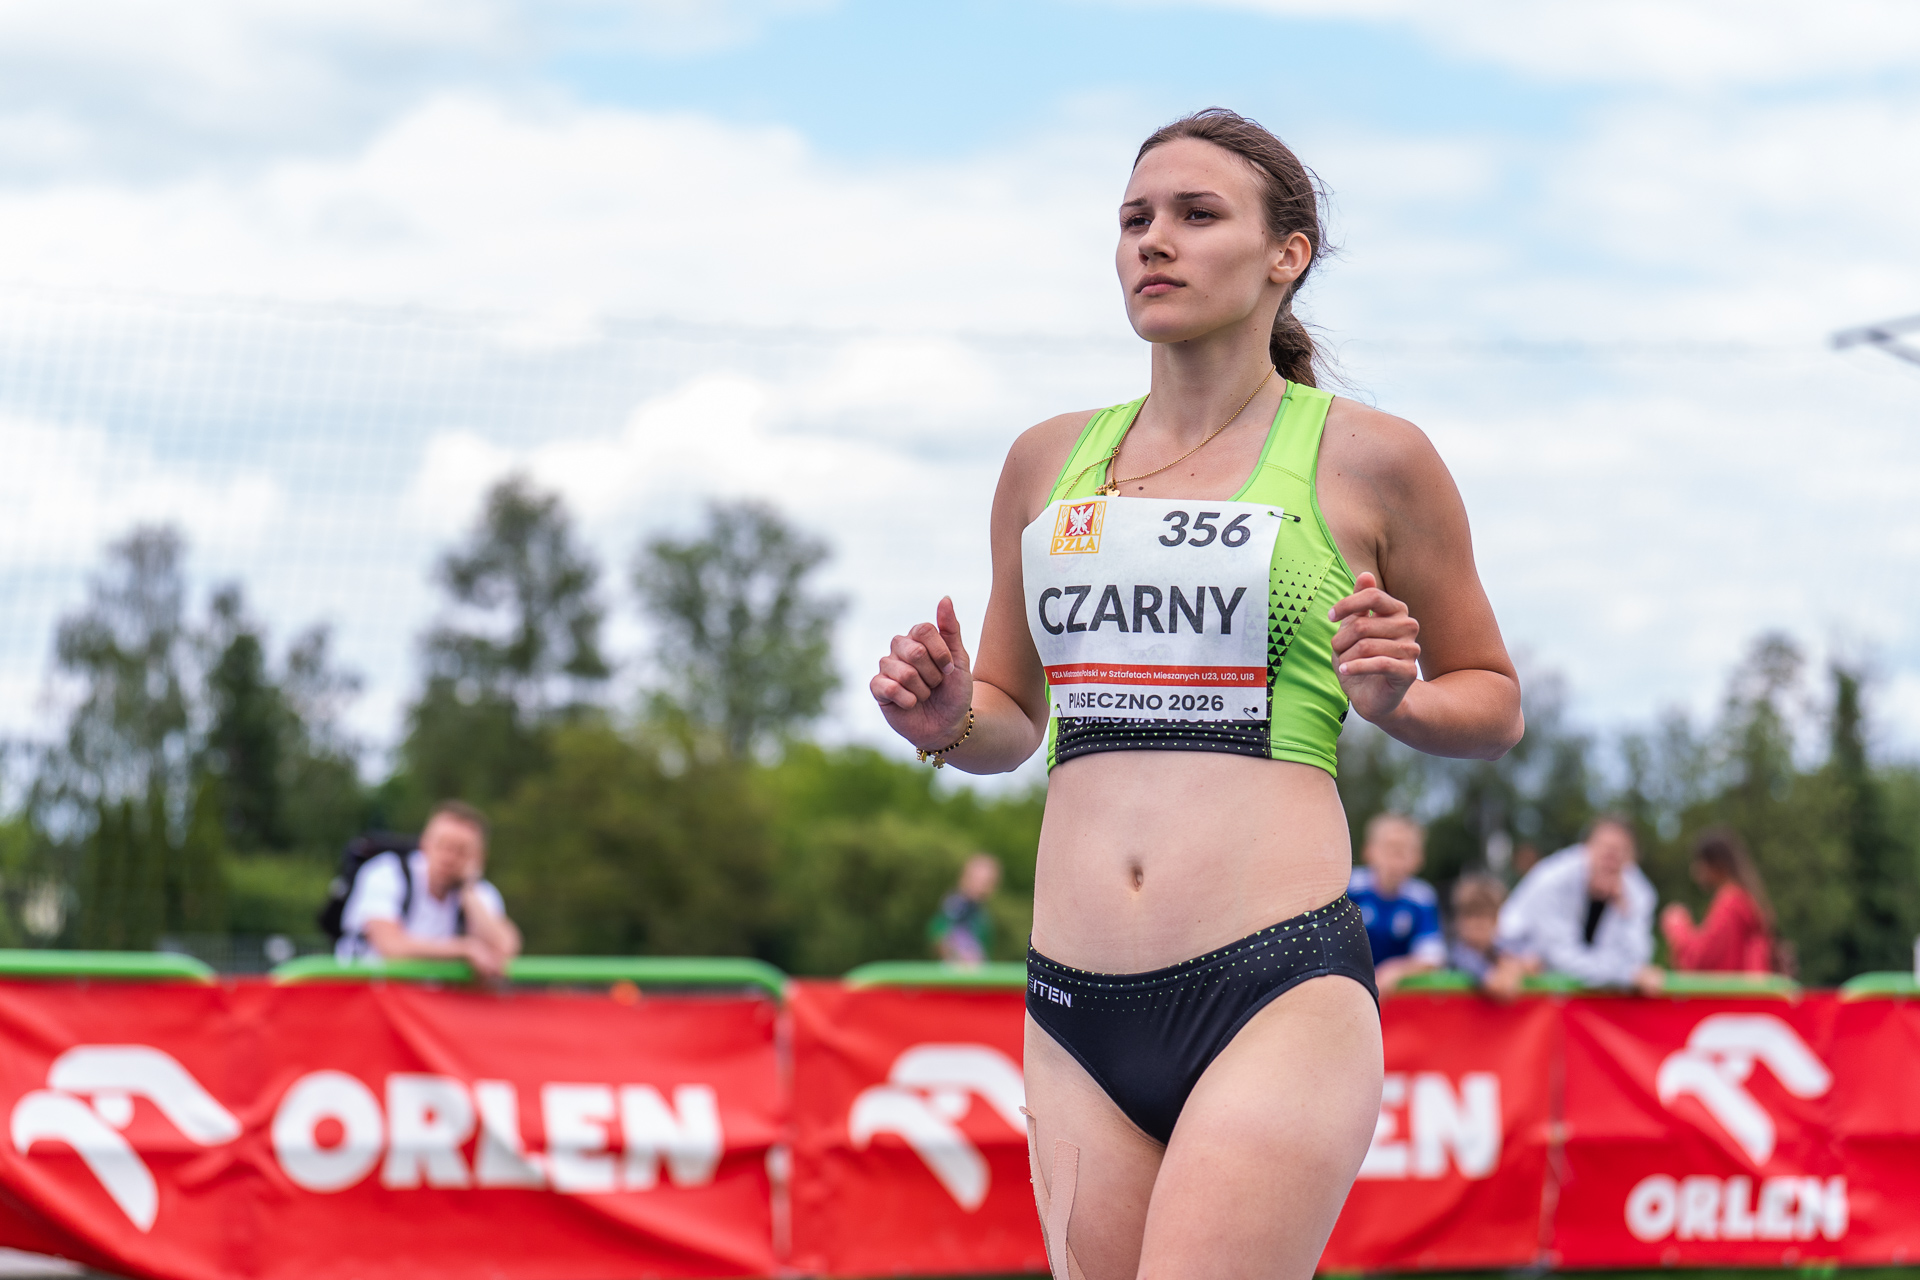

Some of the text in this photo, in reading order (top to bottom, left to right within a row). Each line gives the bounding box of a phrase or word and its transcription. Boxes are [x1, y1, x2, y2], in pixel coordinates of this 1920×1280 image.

[1053, 536, 1096, 552] PZLA
[1158, 510, 1252, 548] 356
[1038, 584, 1247, 635] CZARNY
[1051, 671, 1063, 679] PZLA
[1082, 669, 1099, 677] Polski
[1109, 670, 1152, 679] Sztafetach
[1153, 671, 1200, 681] Mieszanych
[1201, 672, 1219, 681] U23,
[1221, 672, 1238, 681] U20,
[1240, 672, 1255, 681] U18
[1068, 692, 1224, 711] PIASECZNO 2026
[272, 1069, 724, 1193] ORLEN
[1624, 1173, 1849, 1243] ORLEN
